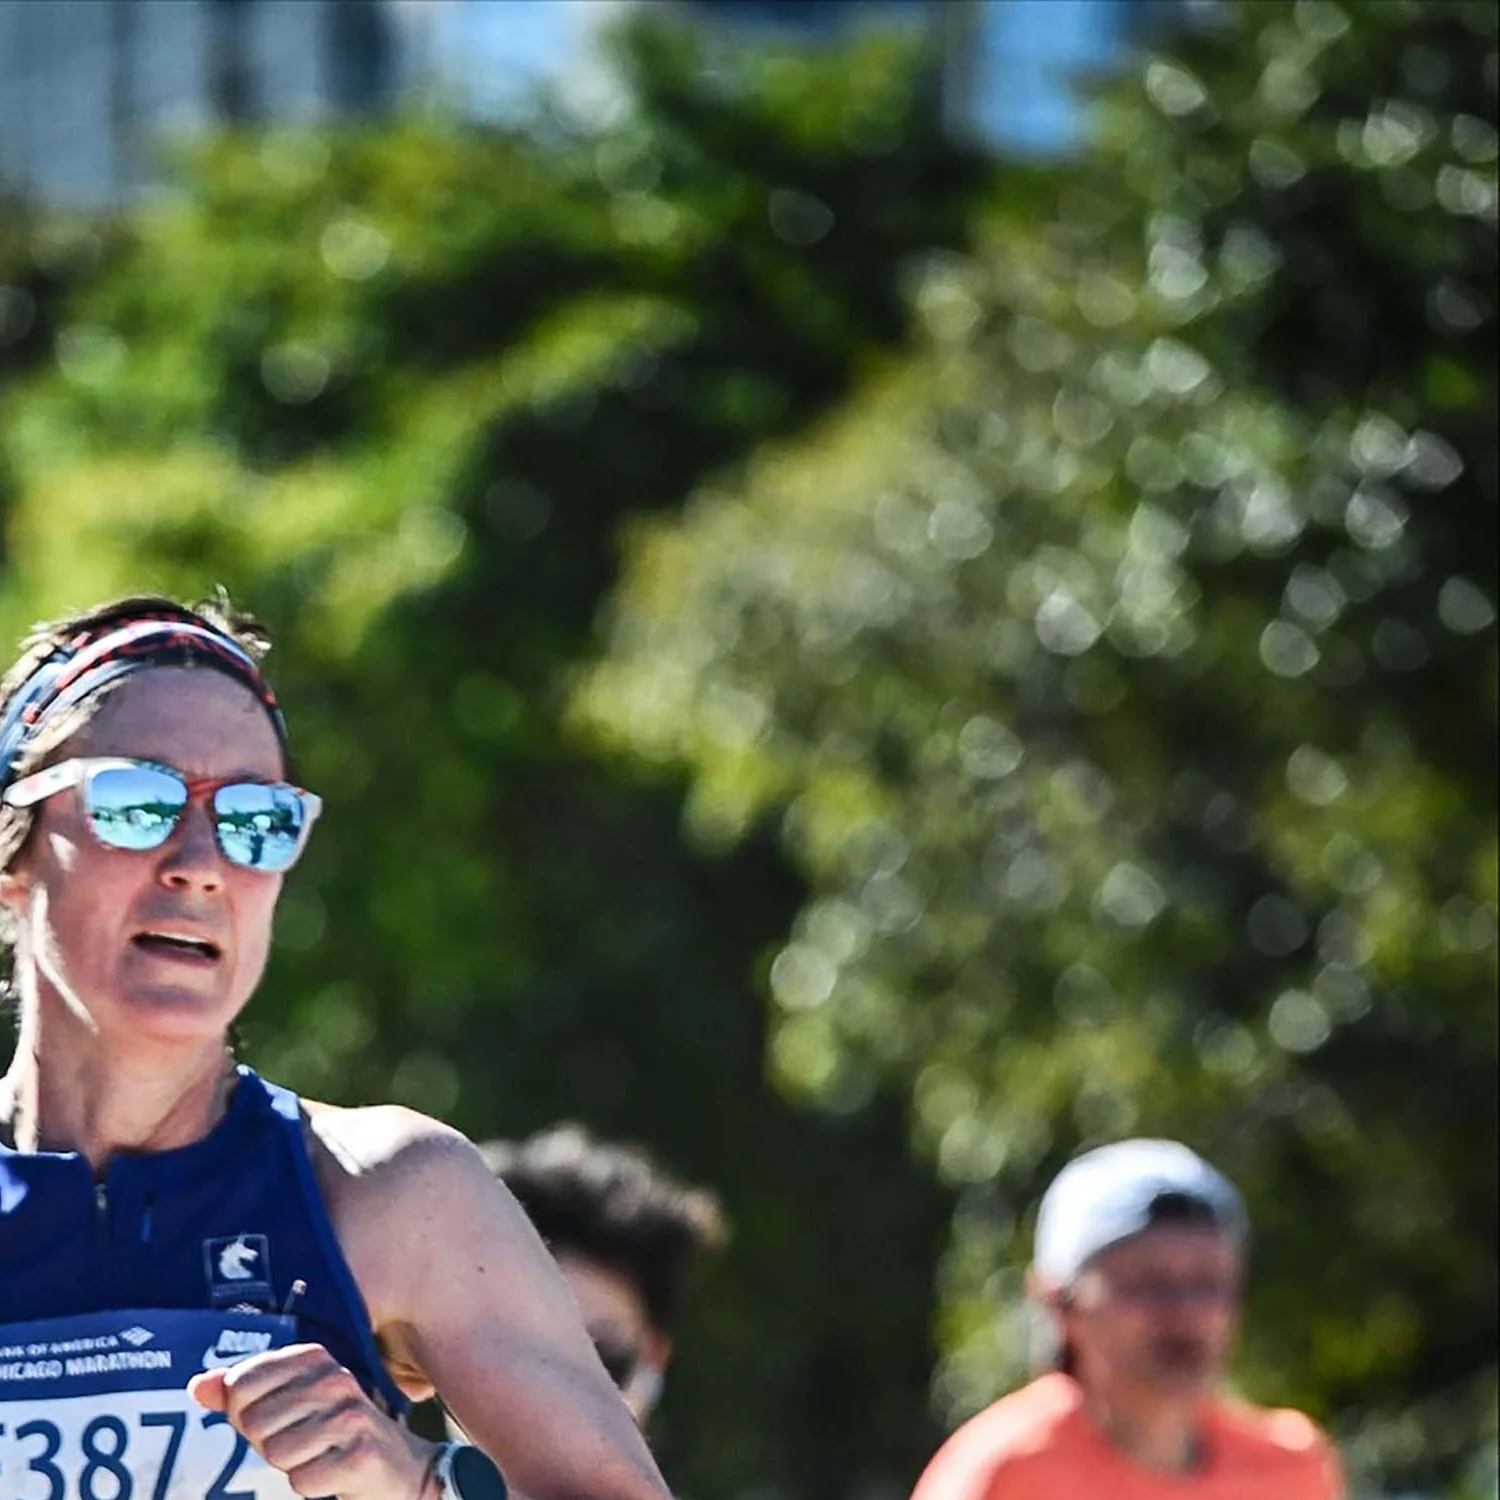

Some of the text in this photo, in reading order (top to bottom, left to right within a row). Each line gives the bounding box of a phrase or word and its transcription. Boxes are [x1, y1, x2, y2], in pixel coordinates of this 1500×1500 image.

[28, 1344, 48, 1357] OF
[51, 1335, 119, 1355] AMERICA
[65, 1350, 172, 1377] MARATHON
